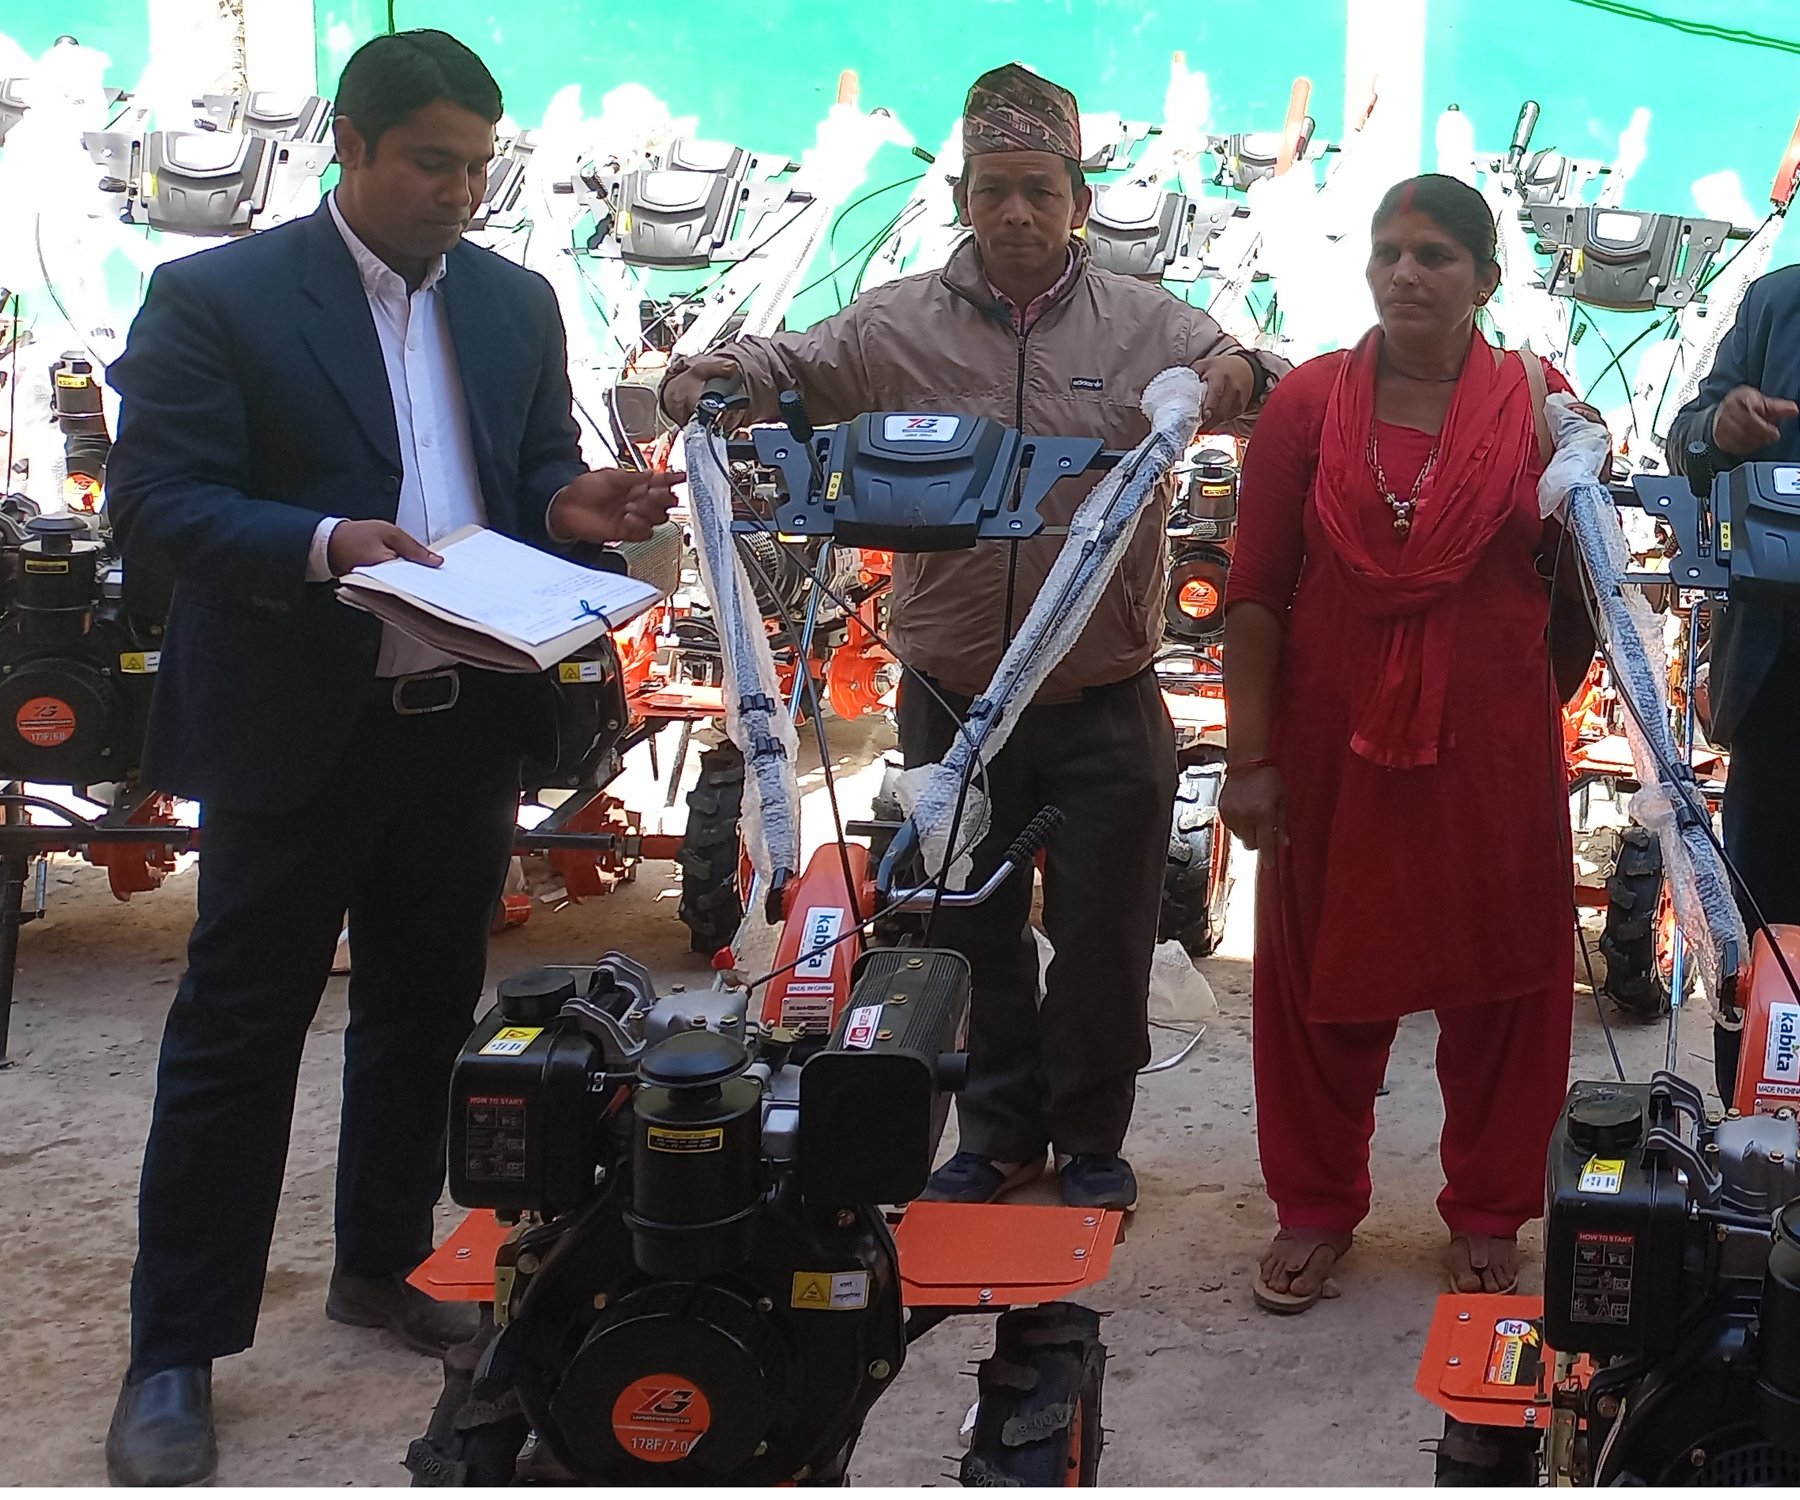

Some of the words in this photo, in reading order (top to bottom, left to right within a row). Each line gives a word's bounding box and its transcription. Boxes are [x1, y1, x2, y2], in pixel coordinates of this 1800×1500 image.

[1776, 1011, 1799, 1072] kabita
[1579, 1233, 1598, 1241] HOW
[1609, 1235, 1633, 1243] START
[631, 1437, 689, 1452] 178F/7.0
